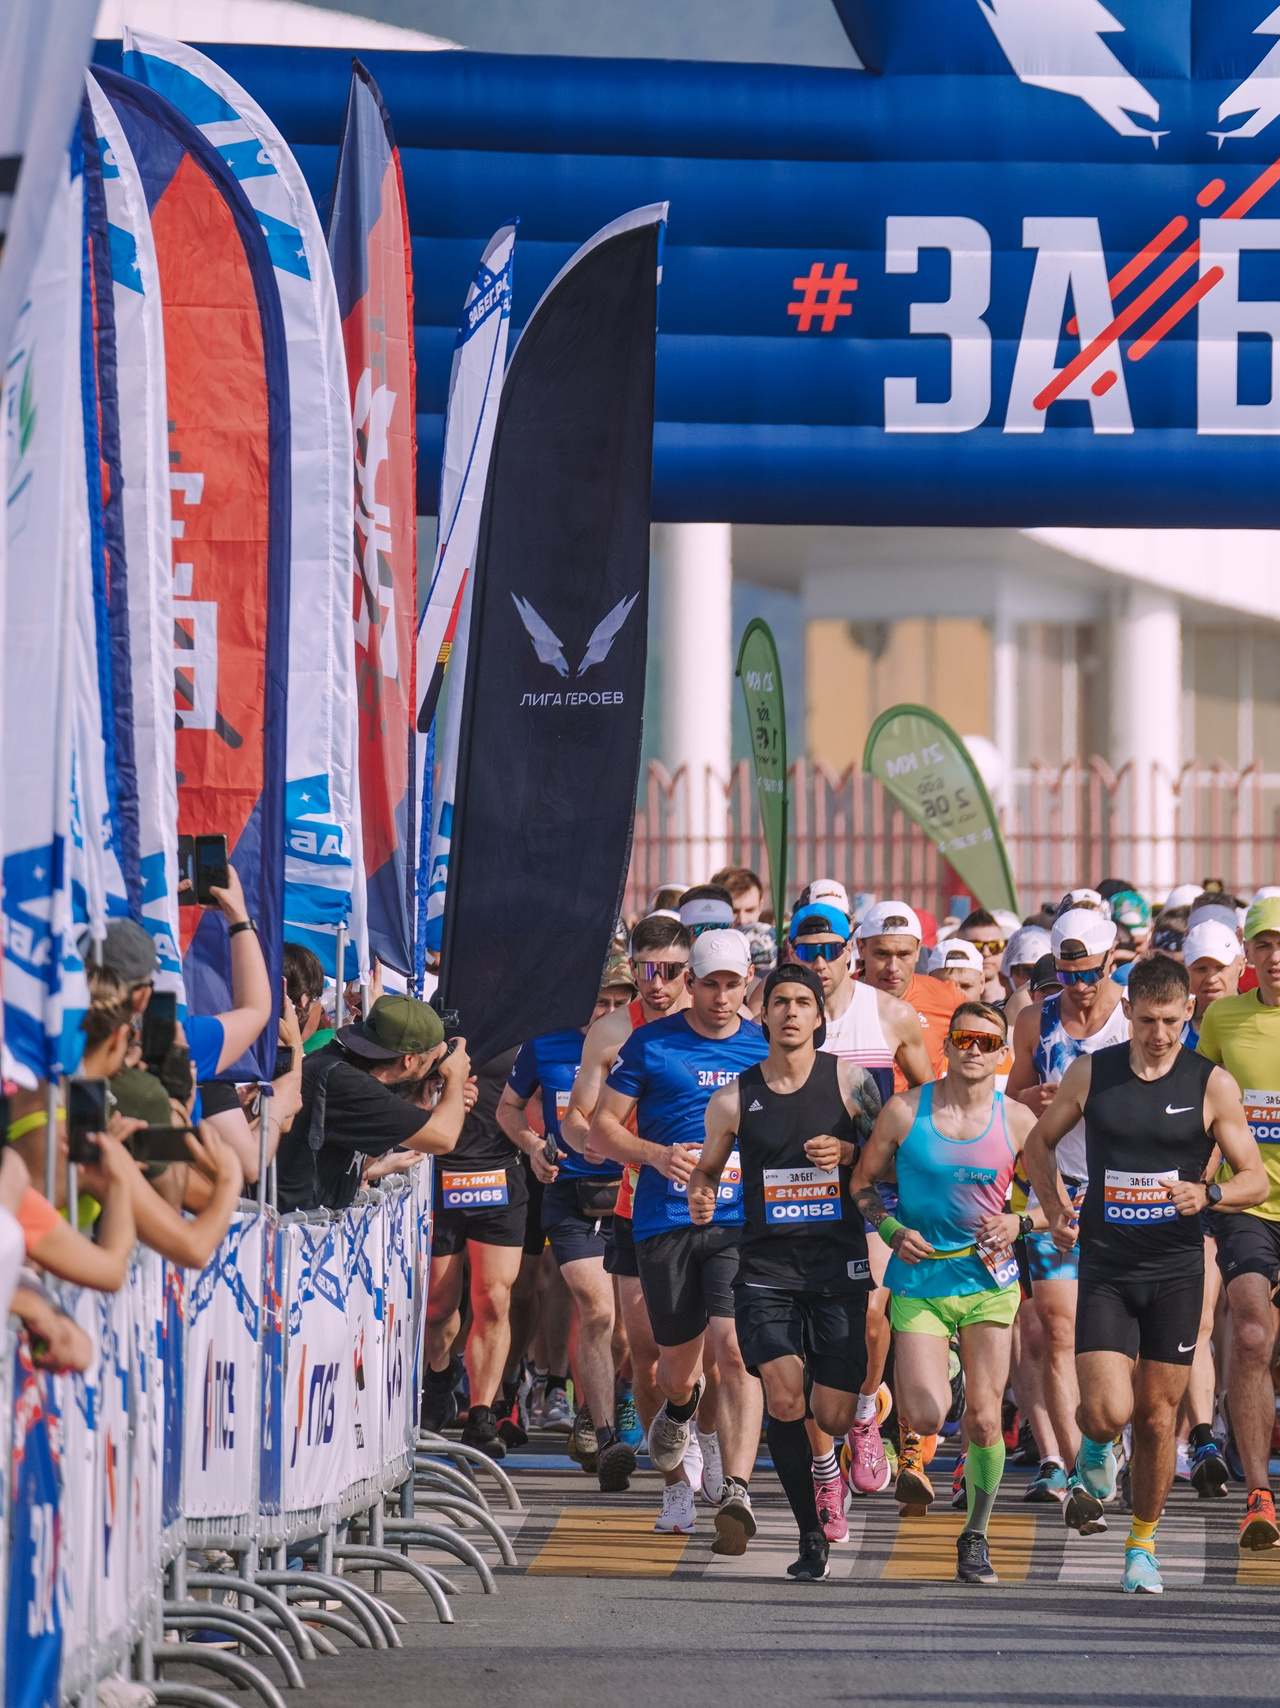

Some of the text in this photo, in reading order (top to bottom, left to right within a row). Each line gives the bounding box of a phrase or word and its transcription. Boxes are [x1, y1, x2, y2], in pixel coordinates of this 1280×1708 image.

[519, 691, 624, 706] ЛИГА ГЕРОЕВ
[970, 1171, 992, 1181] kilpi
[448, 1189, 503, 1204] 00165
[772, 1203, 835, 1218] 00152
[1107, 1205, 1176, 1220] 00036
